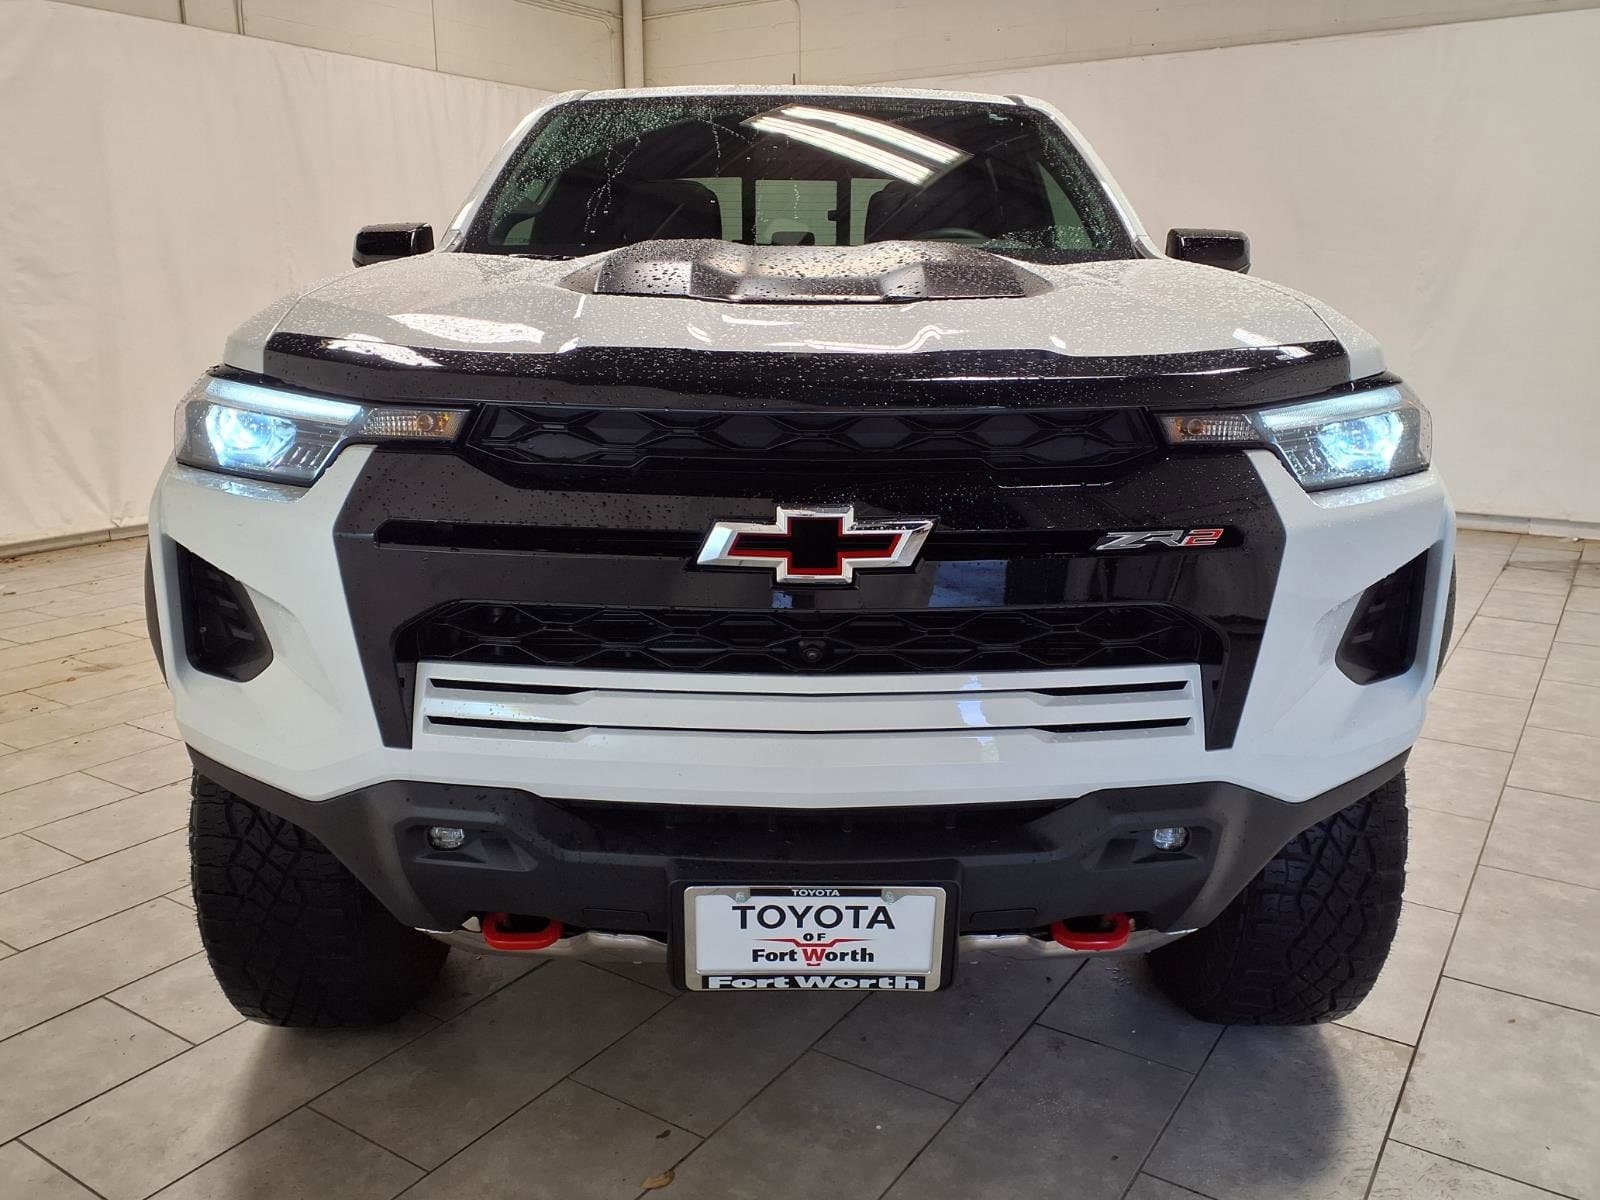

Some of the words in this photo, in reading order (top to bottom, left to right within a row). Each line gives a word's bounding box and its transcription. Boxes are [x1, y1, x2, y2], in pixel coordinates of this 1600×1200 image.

[1096, 528, 1224, 551] ZR2
[792, 889, 840, 897] TOYOTA
[732, 905, 895, 929] TOYOTA
[803, 933, 826, 942] OF
[752, 949, 798, 963] Fort
[803, 948, 875, 963] Worth
[708, 976, 790, 989] Fort
[795, 976, 919, 989] Worth
